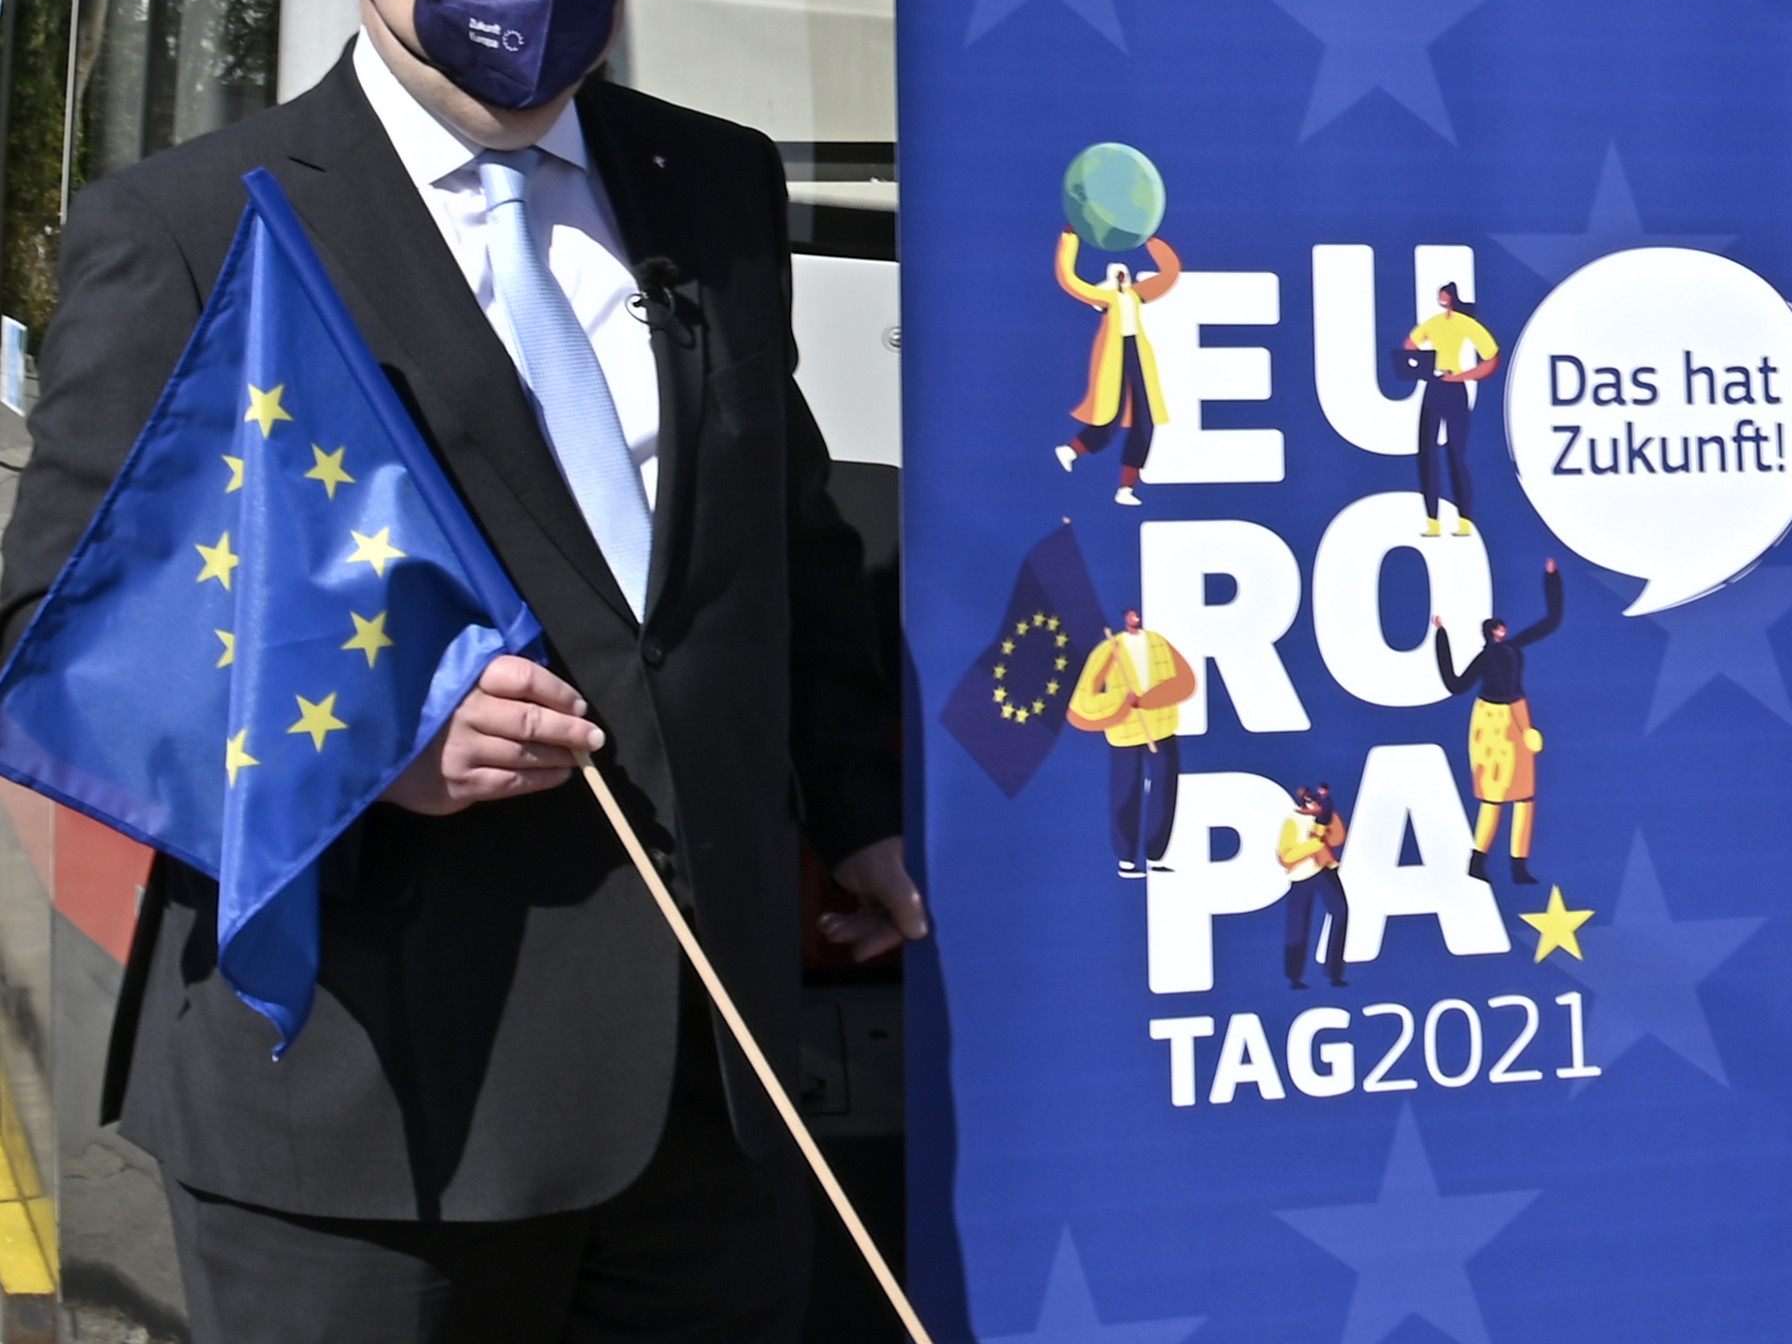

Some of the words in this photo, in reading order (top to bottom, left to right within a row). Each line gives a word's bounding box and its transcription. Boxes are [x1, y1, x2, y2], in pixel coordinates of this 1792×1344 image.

[1548, 353, 1659, 407] Das
[1683, 349, 1782, 405] hat
[1550, 418, 1786, 476] Zukunft!
